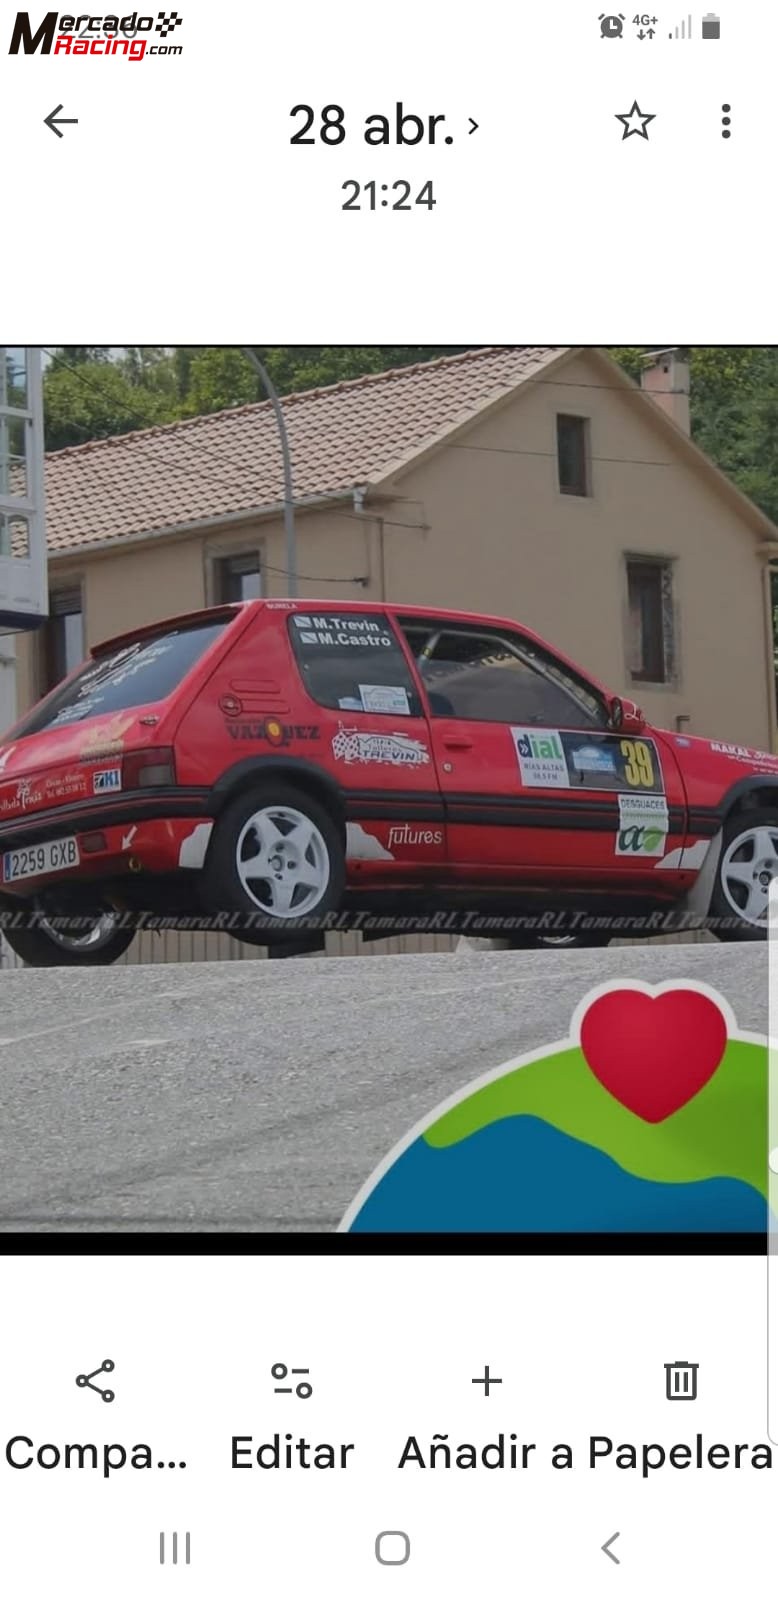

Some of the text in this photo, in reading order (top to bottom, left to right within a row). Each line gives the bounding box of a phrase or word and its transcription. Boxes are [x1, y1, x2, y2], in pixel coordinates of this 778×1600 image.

[632, 14, 658, 26] 4G+
[290, 102, 453, 145] 28 abr.
[342, 180, 436, 210] 21:24
[313, 616, 380, 633] M.Trevin
[319, 631, 391, 647] M.Castro
[517, 733, 562, 759] dial
[620, 739, 655, 787] 39
[620, 798, 665, 810] DESGUACES
[388, 822, 443, 849] futures
[12, 840, 77, 877] 2259 GXB
[6, 1436, 186, 1478] Compa...
[232, 1434, 354, 1469] Editar
[398, 1434, 572, 1469] Añadir a
[590, 1434, 772, 1478] Papelera
